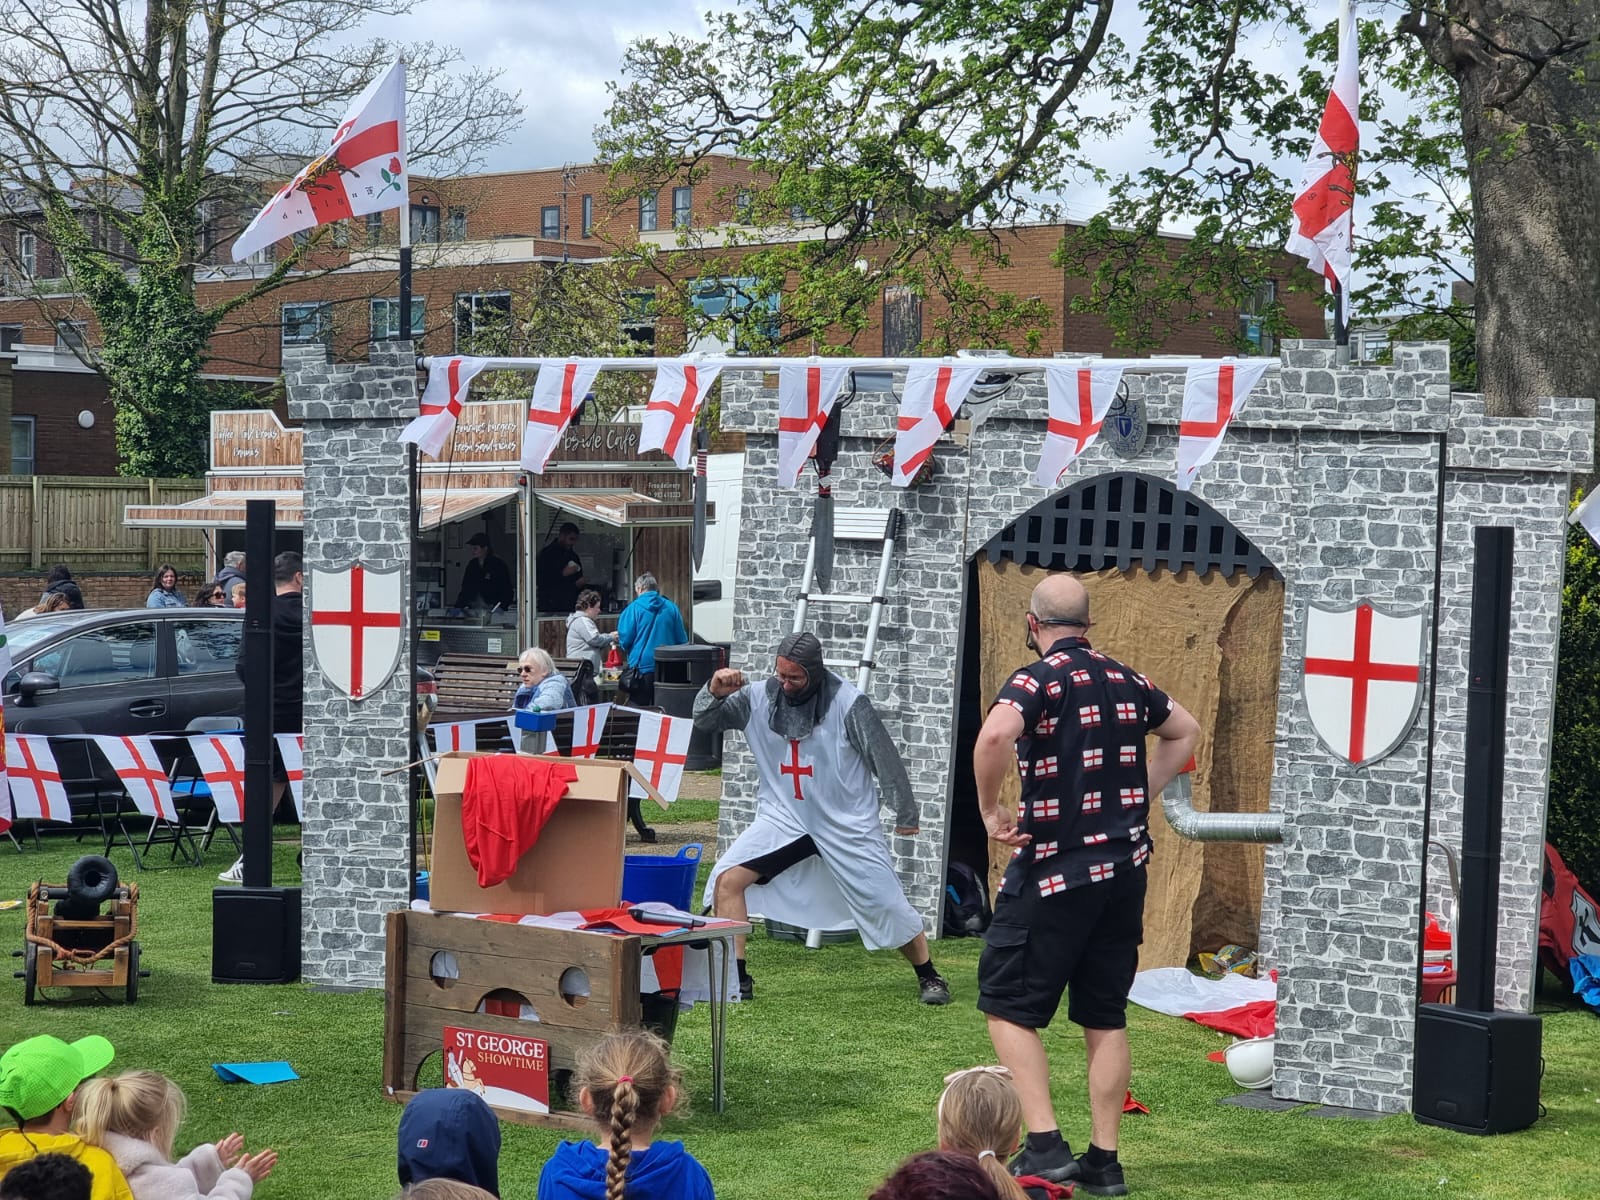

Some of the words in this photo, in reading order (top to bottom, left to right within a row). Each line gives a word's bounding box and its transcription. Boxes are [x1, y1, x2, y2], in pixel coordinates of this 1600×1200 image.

[606, 427, 637, 454] Cafe
[456, 1031, 474, 1048] ST
[476, 1035, 544, 1058] GEORGE
[477, 1051, 544, 1071] SHOWTIME
